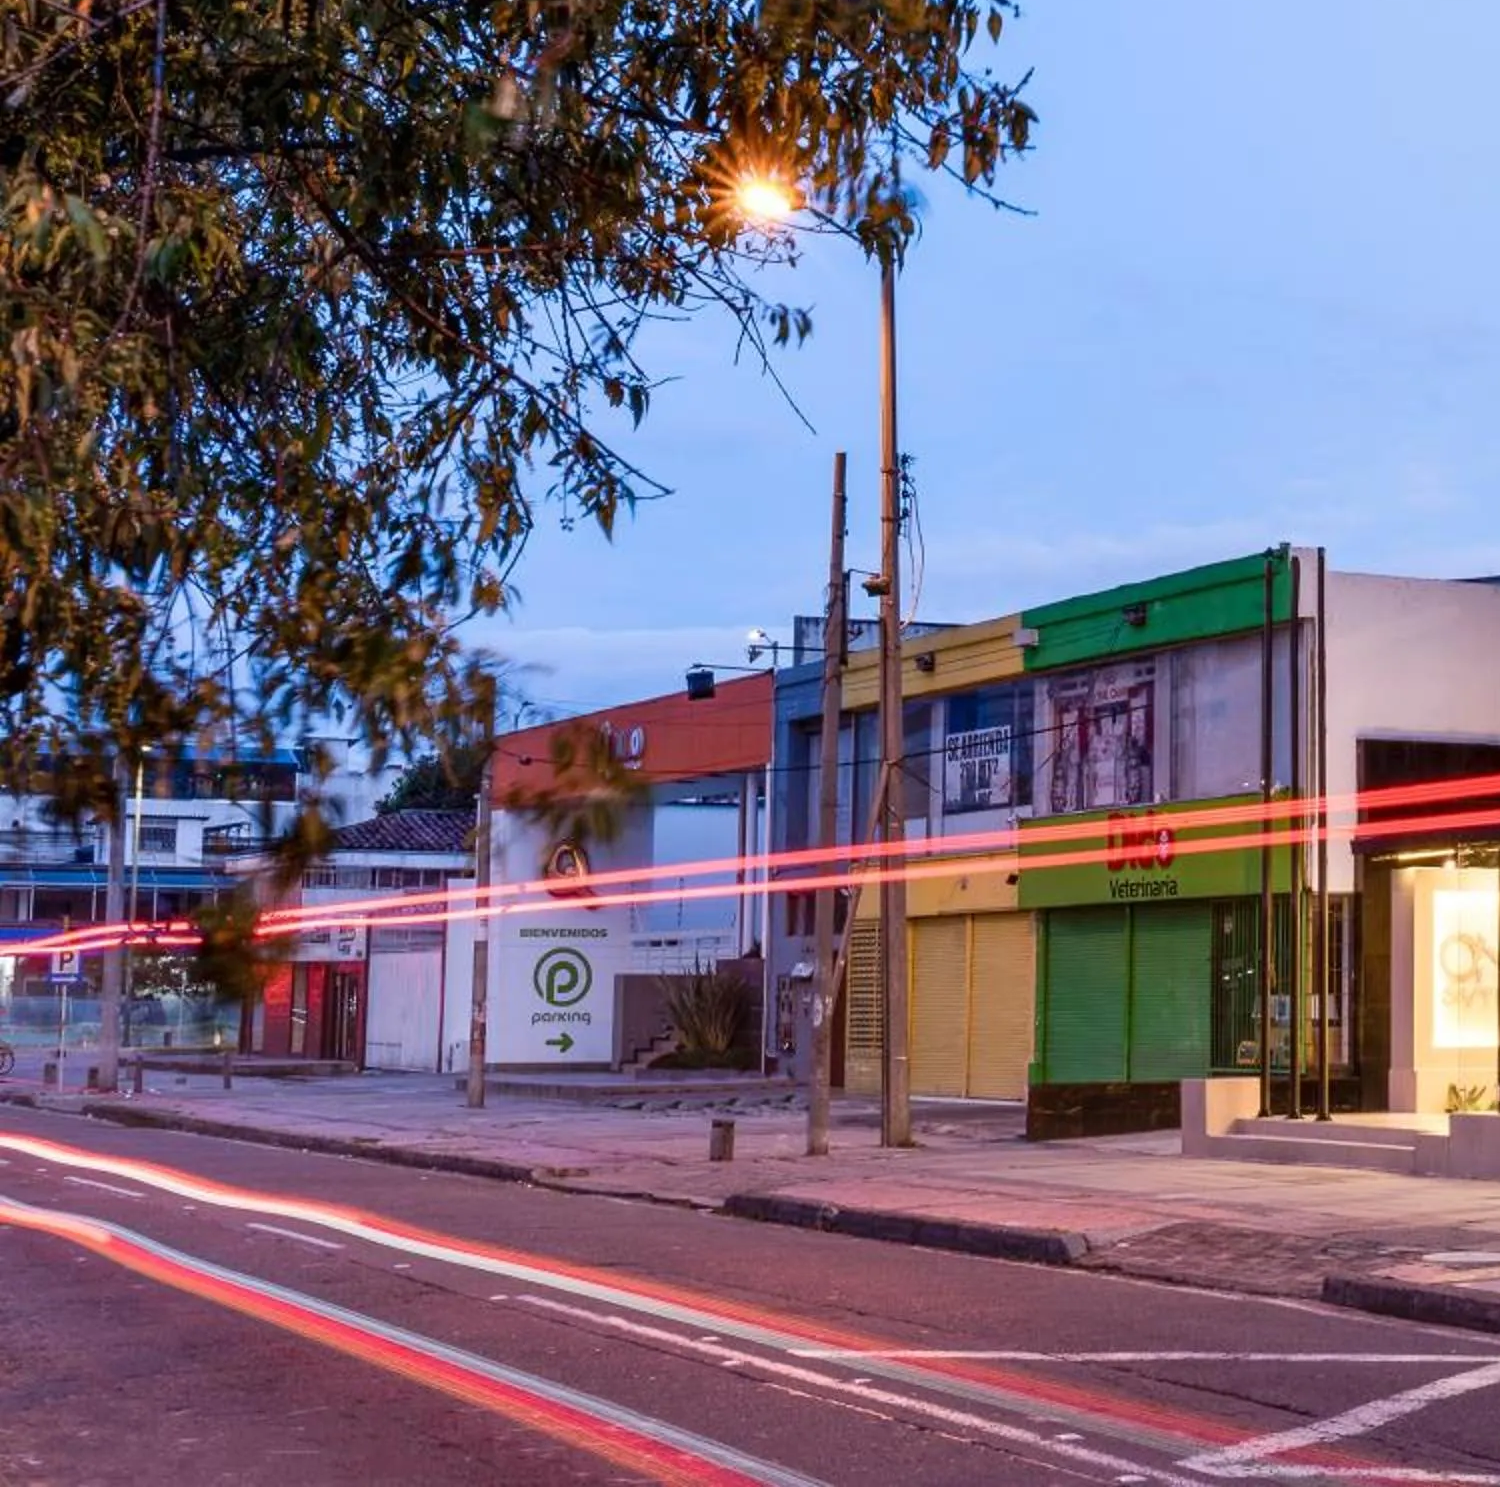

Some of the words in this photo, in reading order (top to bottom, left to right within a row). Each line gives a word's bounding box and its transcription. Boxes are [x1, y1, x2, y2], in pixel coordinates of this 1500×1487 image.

[1109, 875, 1179, 899] Veterinaria
[519, 927, 609, 938] BIENVENIDOS
[60, 950, 74, 972] P
[531, 1012, 592, 1025] parking
